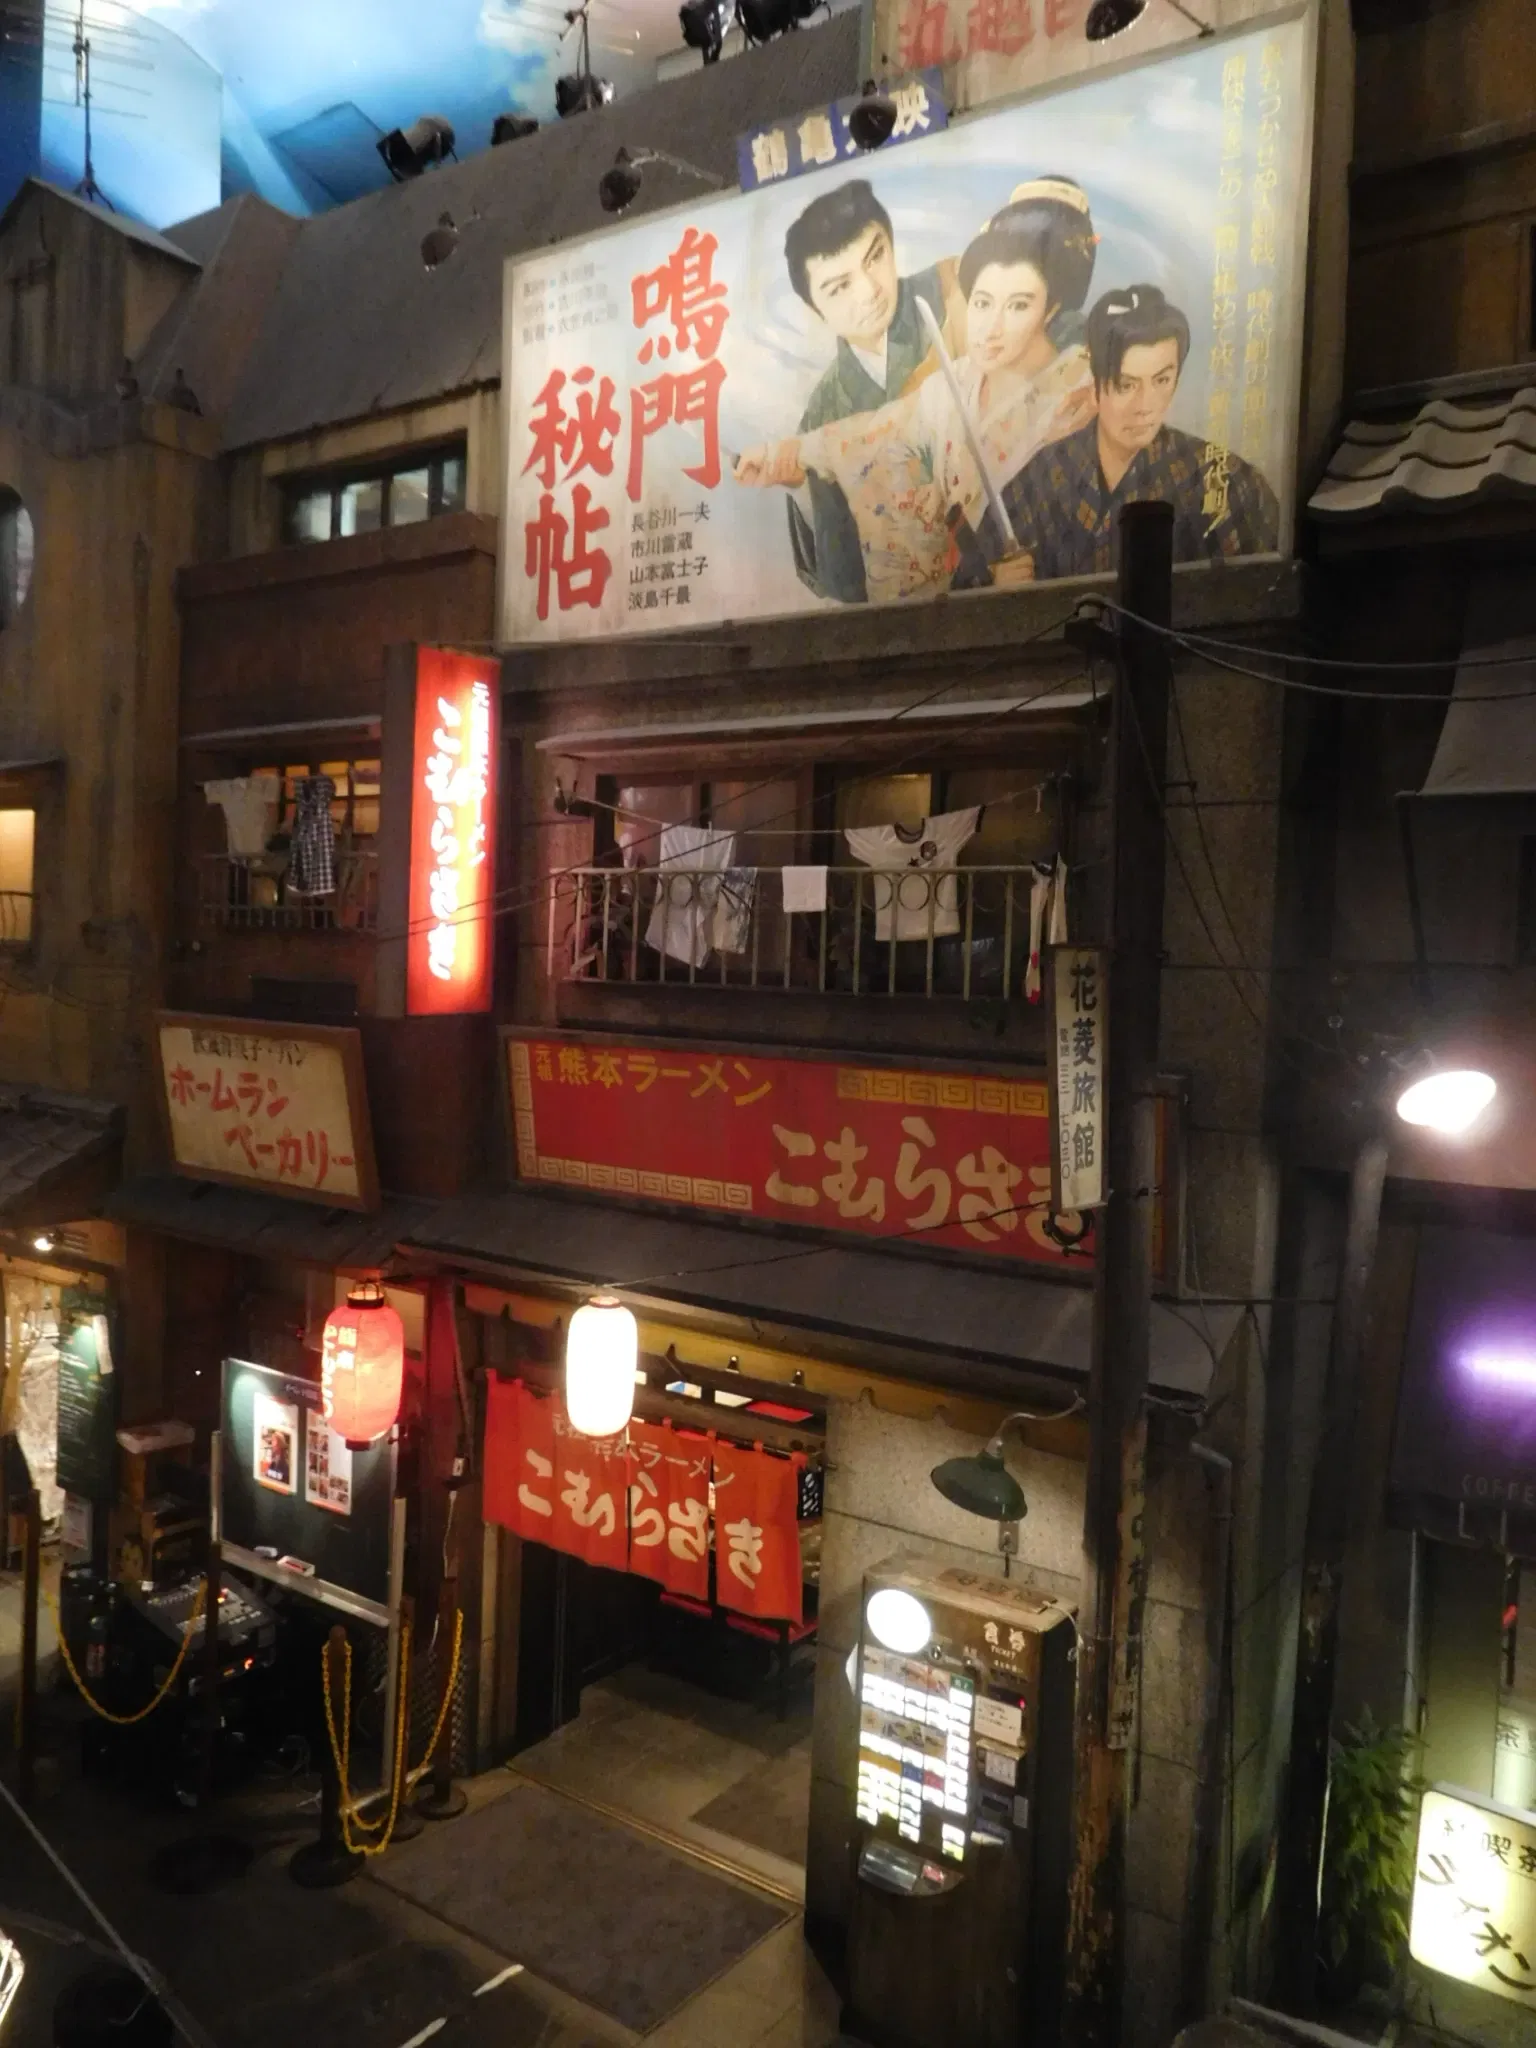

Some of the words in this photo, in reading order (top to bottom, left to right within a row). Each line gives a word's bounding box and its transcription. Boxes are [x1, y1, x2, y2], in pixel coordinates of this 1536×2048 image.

[625, 226, 731, 503] 鳴門
[520, 365, 622, 622] 秘帖
[631, 501, 712, 533] 長谷川一夫
[629, 556, 709, 585] 山本富士子
[630, 531, 693, 558] 市川雷蔵
[169, 1062, 290, 1119] ホームラン
[557, 1046, 773, 1107] 熊本ラーメン
[517, 1448, 764, 1590] こむらさき
